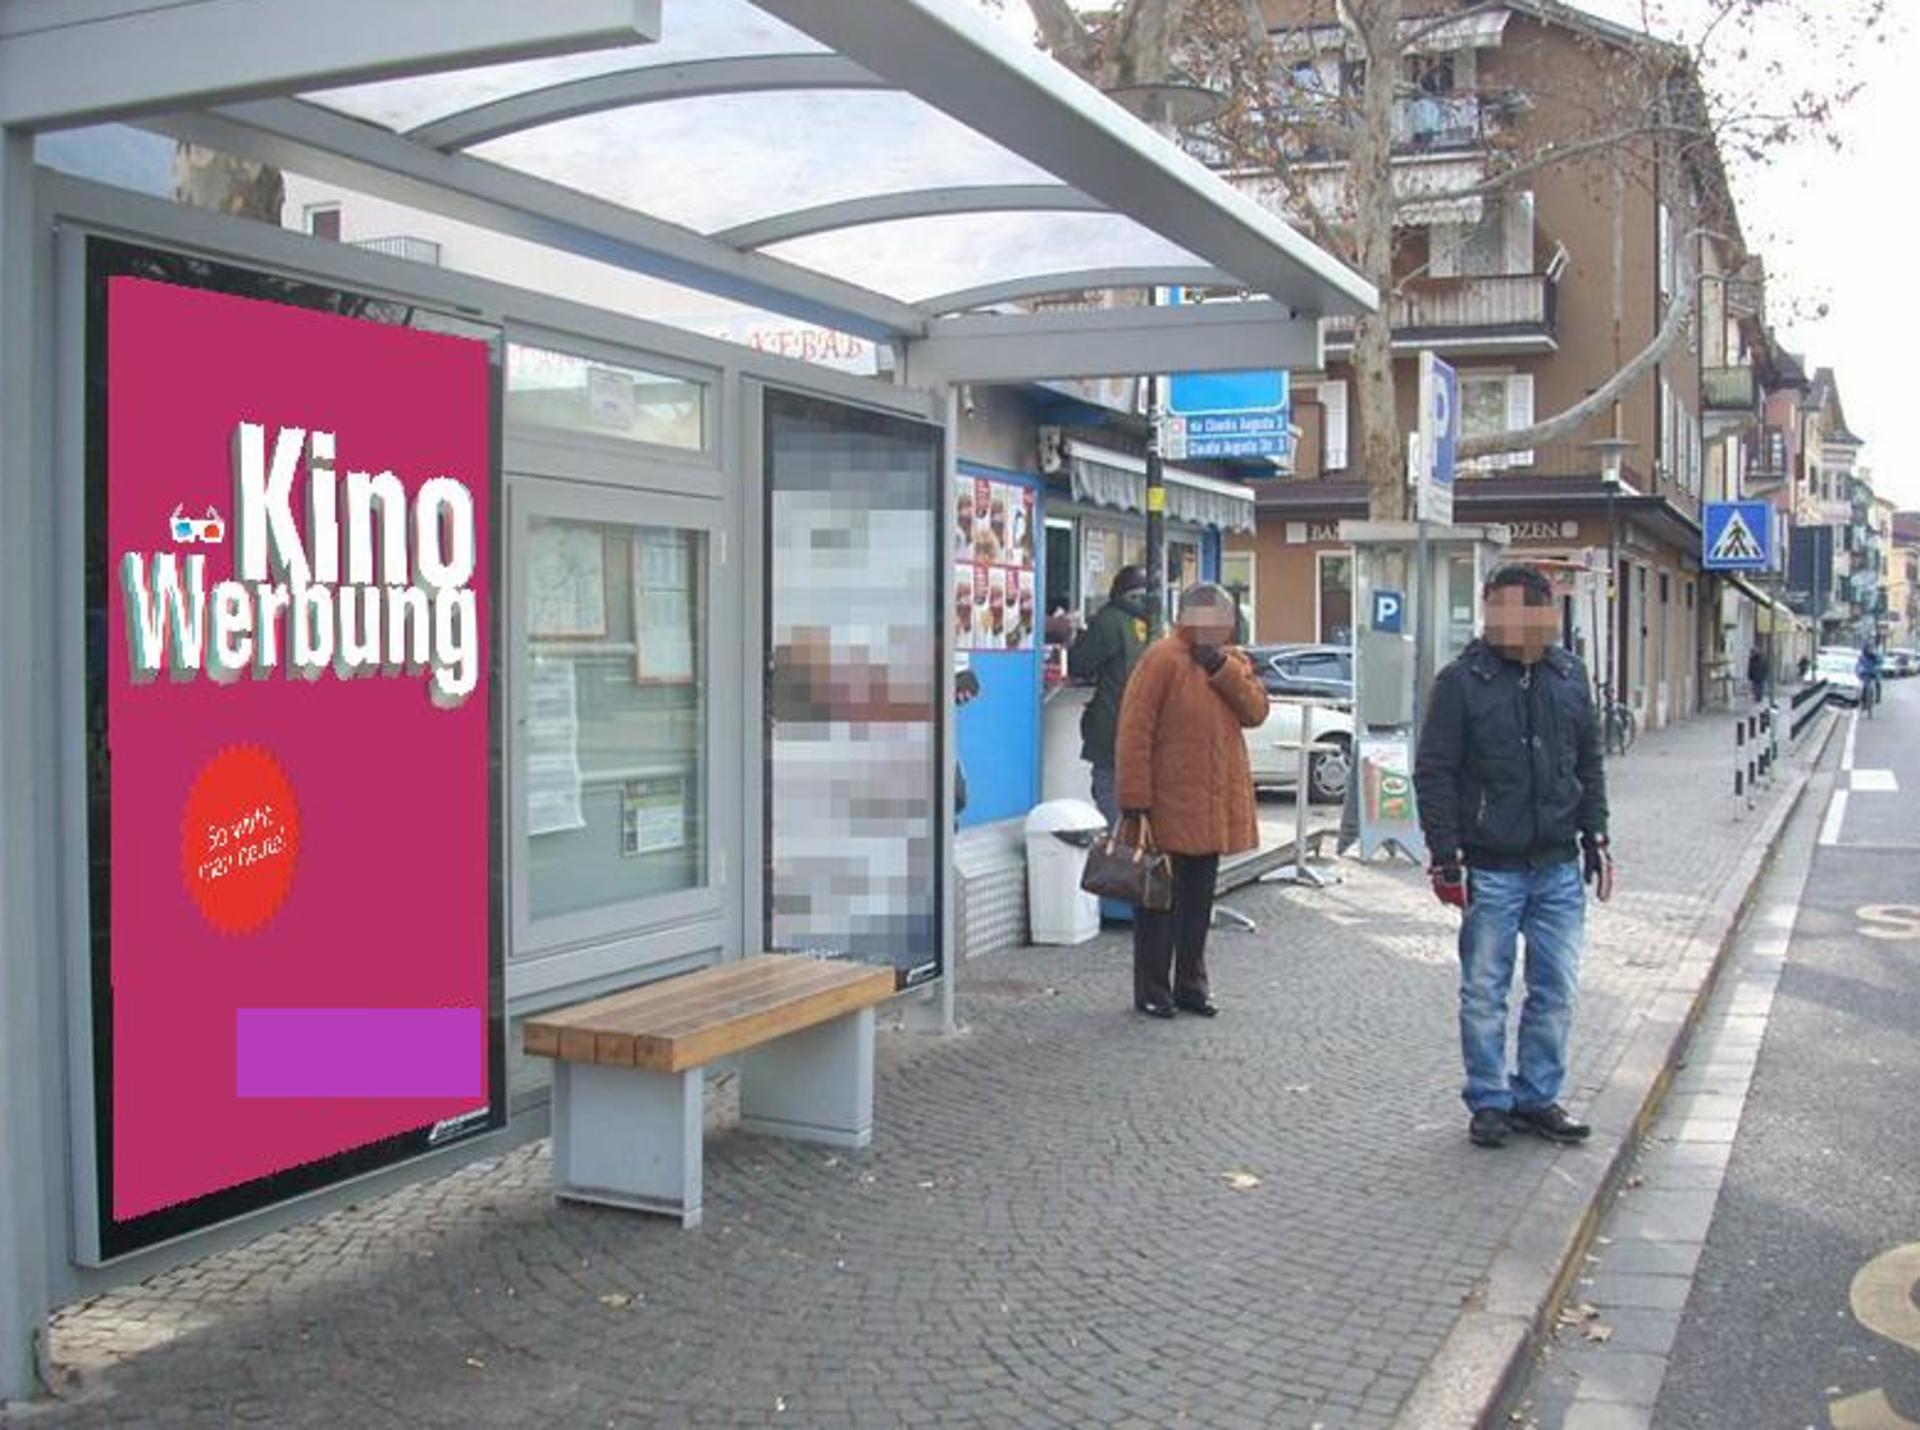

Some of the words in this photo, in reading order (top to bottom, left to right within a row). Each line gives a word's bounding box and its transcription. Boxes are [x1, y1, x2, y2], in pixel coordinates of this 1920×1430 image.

[231, 421, 477, 590] Kino
[120, 551, 478, 706] Werbung
[1376, 597, 1398, 623] P
